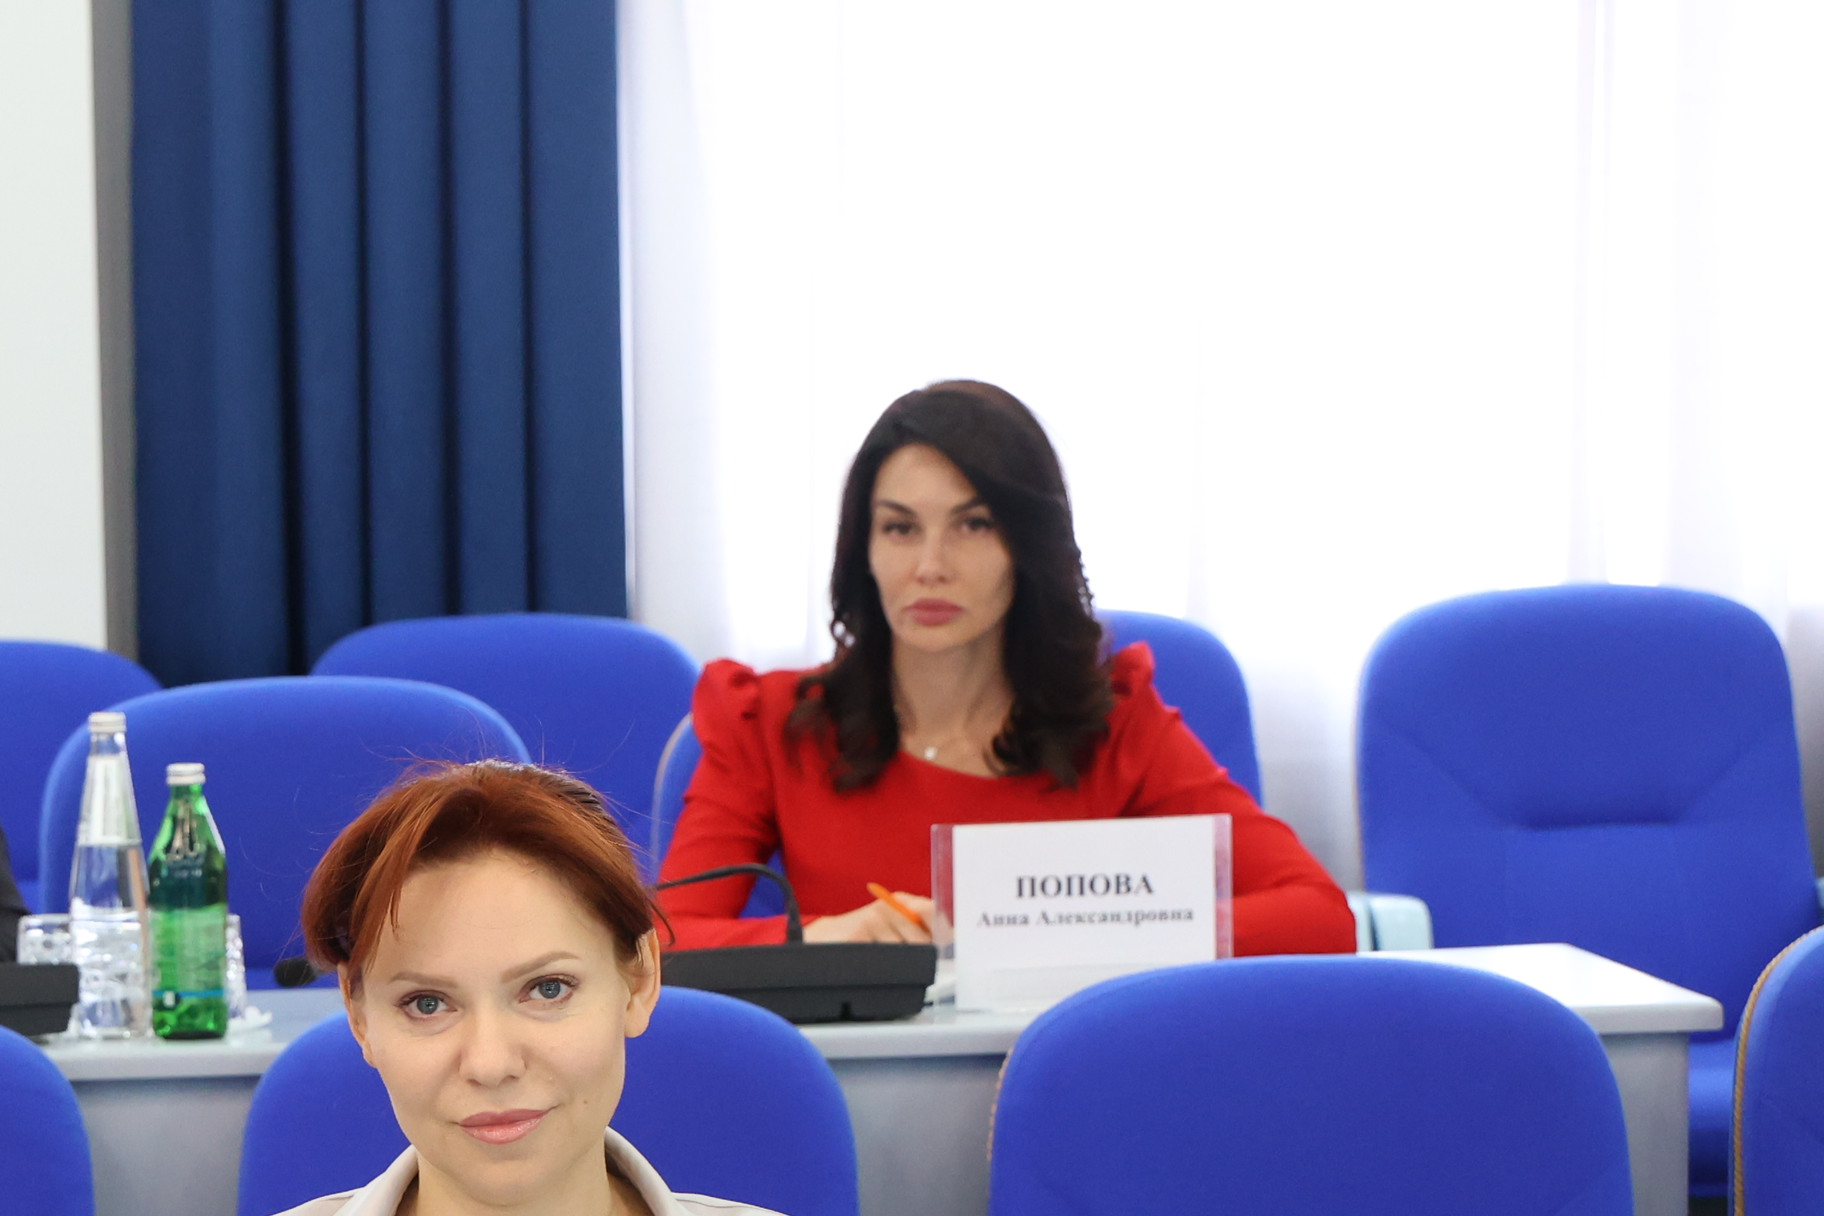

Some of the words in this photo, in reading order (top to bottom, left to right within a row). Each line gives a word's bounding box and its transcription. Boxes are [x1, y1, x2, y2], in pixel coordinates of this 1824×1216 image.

[1016, 872, 1155, 899] ПОПОВА
[977, 910, 1030, 927] Анна
[1036, 908, 1194, 928] Александровна
